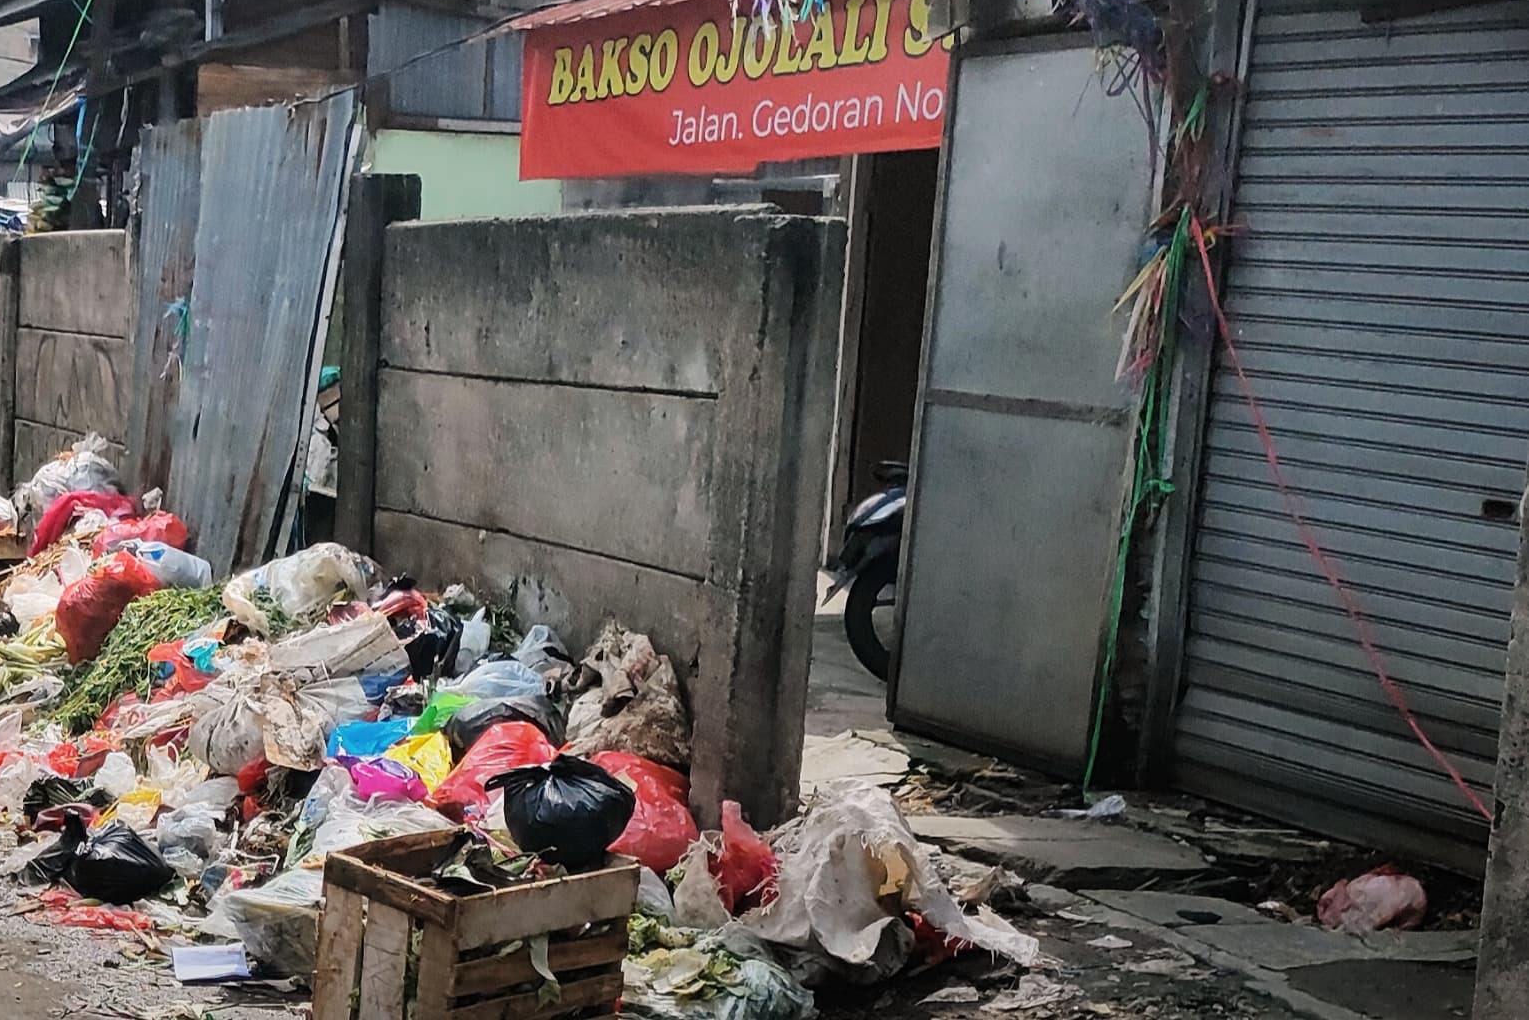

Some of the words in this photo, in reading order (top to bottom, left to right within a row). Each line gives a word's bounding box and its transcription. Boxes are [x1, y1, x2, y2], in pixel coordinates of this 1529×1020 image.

[548, 28, 679, 106] BAKSO
[668, 106, 744, 146] Jalan.
[752, 93, 883, 138] Gedoran
[895, 81, 944, 123] No
